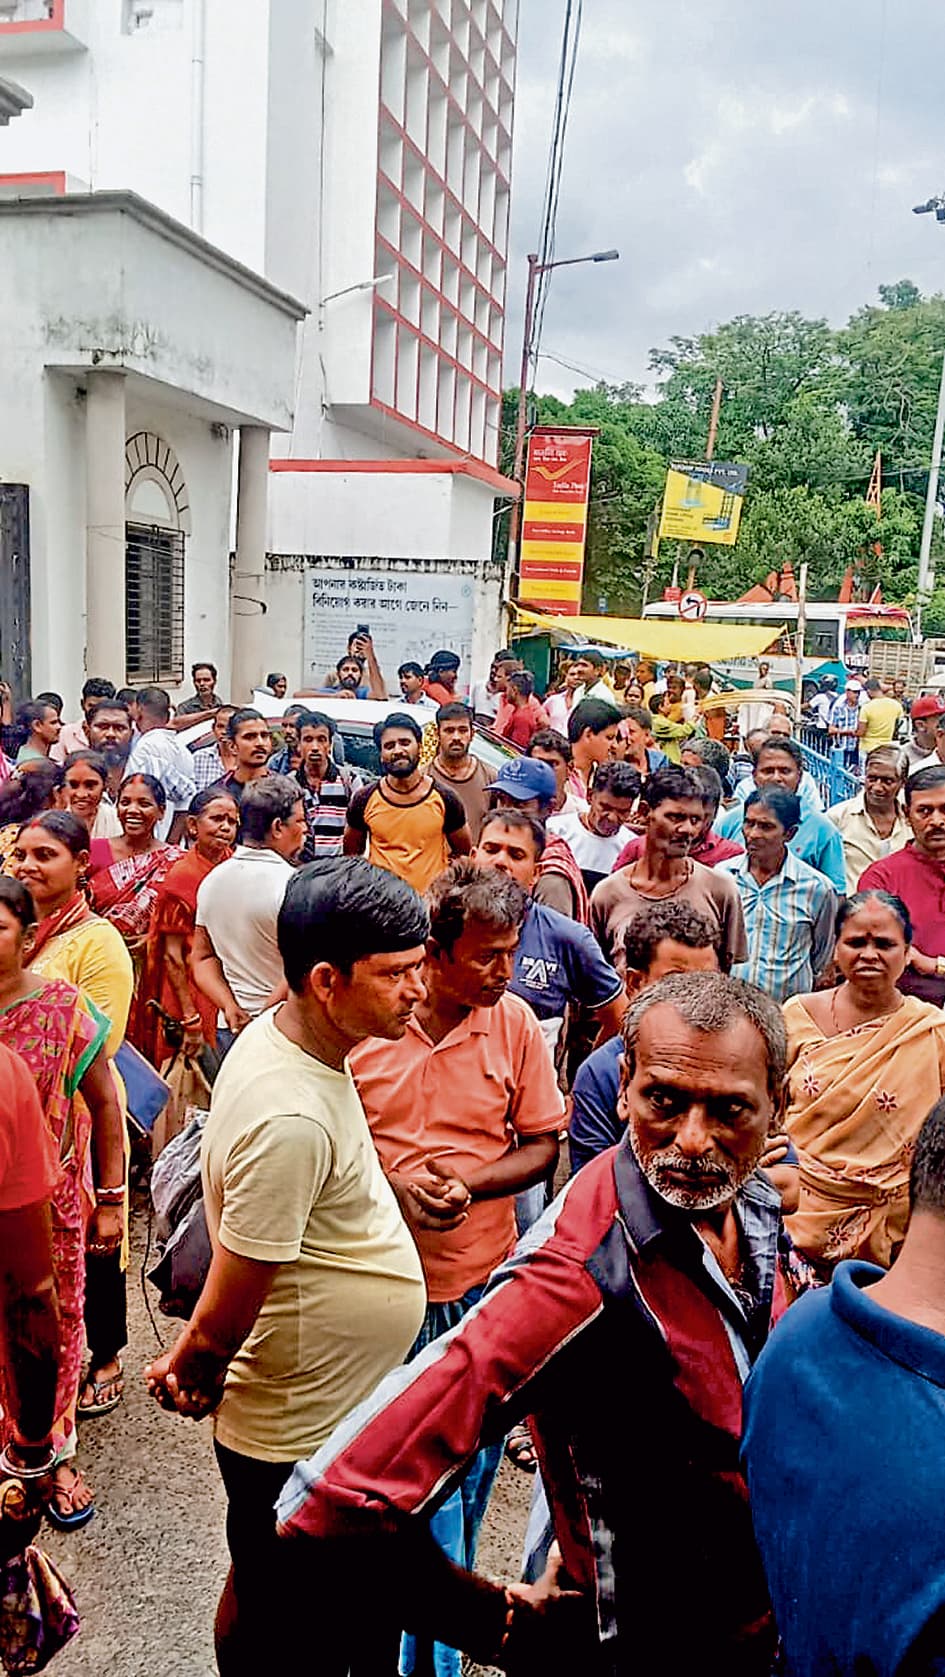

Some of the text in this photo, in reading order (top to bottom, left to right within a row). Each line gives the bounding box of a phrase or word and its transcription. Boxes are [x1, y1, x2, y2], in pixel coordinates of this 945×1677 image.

[312, 578, 346, 590] আপনার
[387, 579, 408, 593] টাকা
[353, 597, 376, 609] করার
[378, 598, 402, 611] আগে
[405, 600, 430, 612] জেনে
